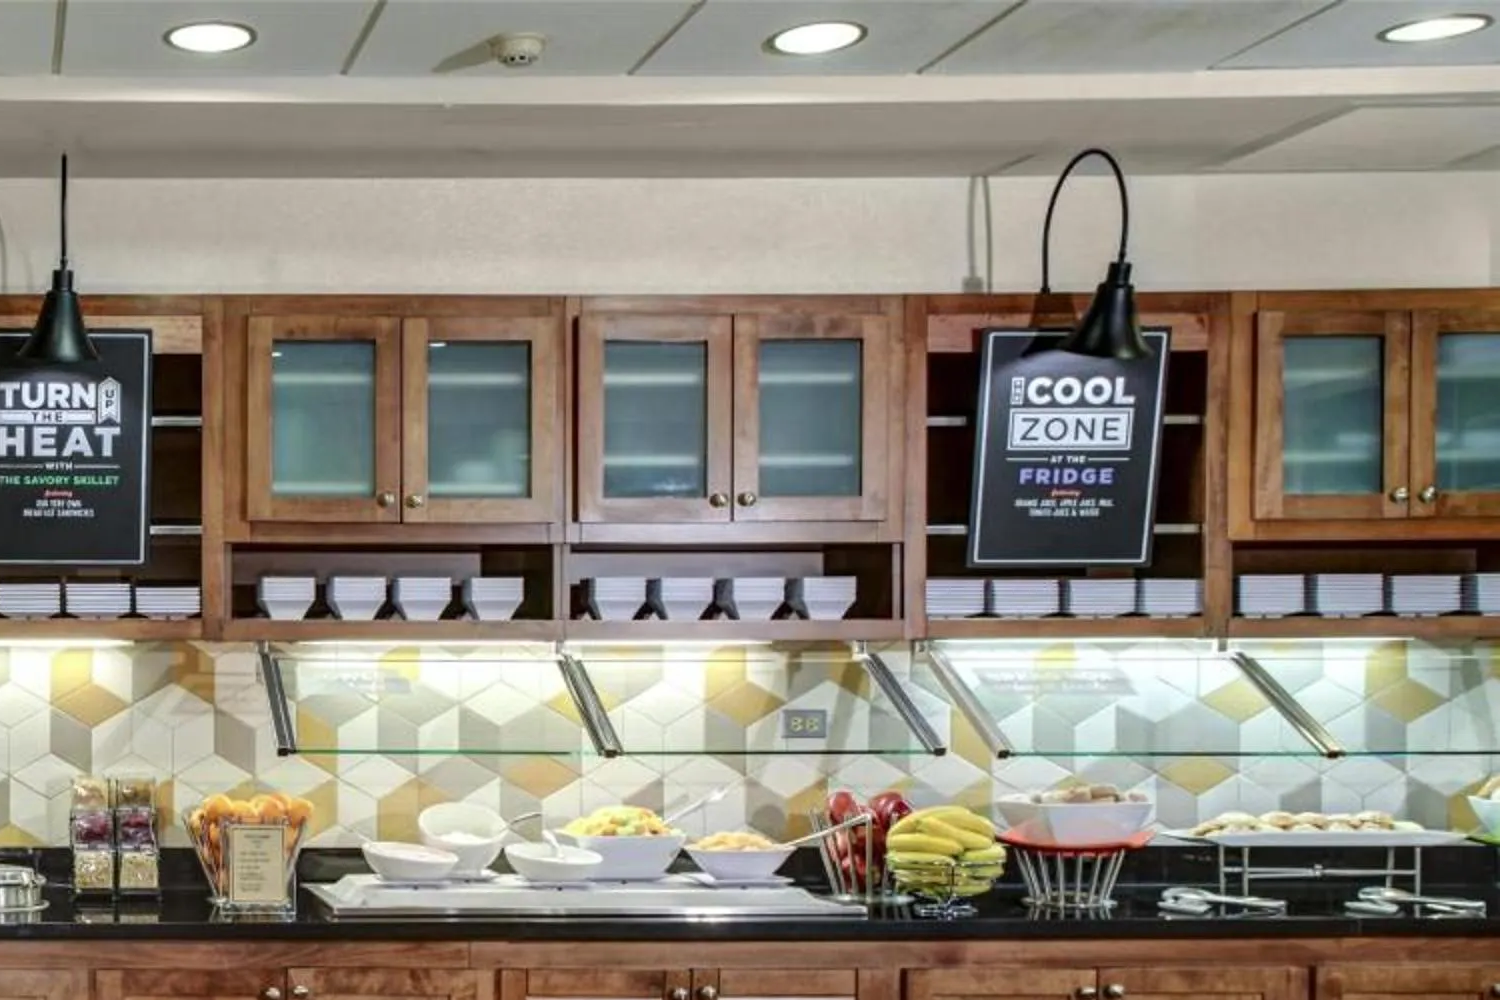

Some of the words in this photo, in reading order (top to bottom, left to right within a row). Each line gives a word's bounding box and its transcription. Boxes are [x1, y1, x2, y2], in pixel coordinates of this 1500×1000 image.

[105, 389, 115, 409] UP
[1027, 376, 1136, 405] COOL
[32, 411, 63, 423] THE
[1019, 417, 1121, 441] ZONE
[45, 461, 73, 471] WITH
[0, 475, 20, 485] THE
[23, 475, 70, 485] SAVORY
[73, 475, 120, 485] SKILLET
[1019, 467, 1115, 485] FRIDGE
